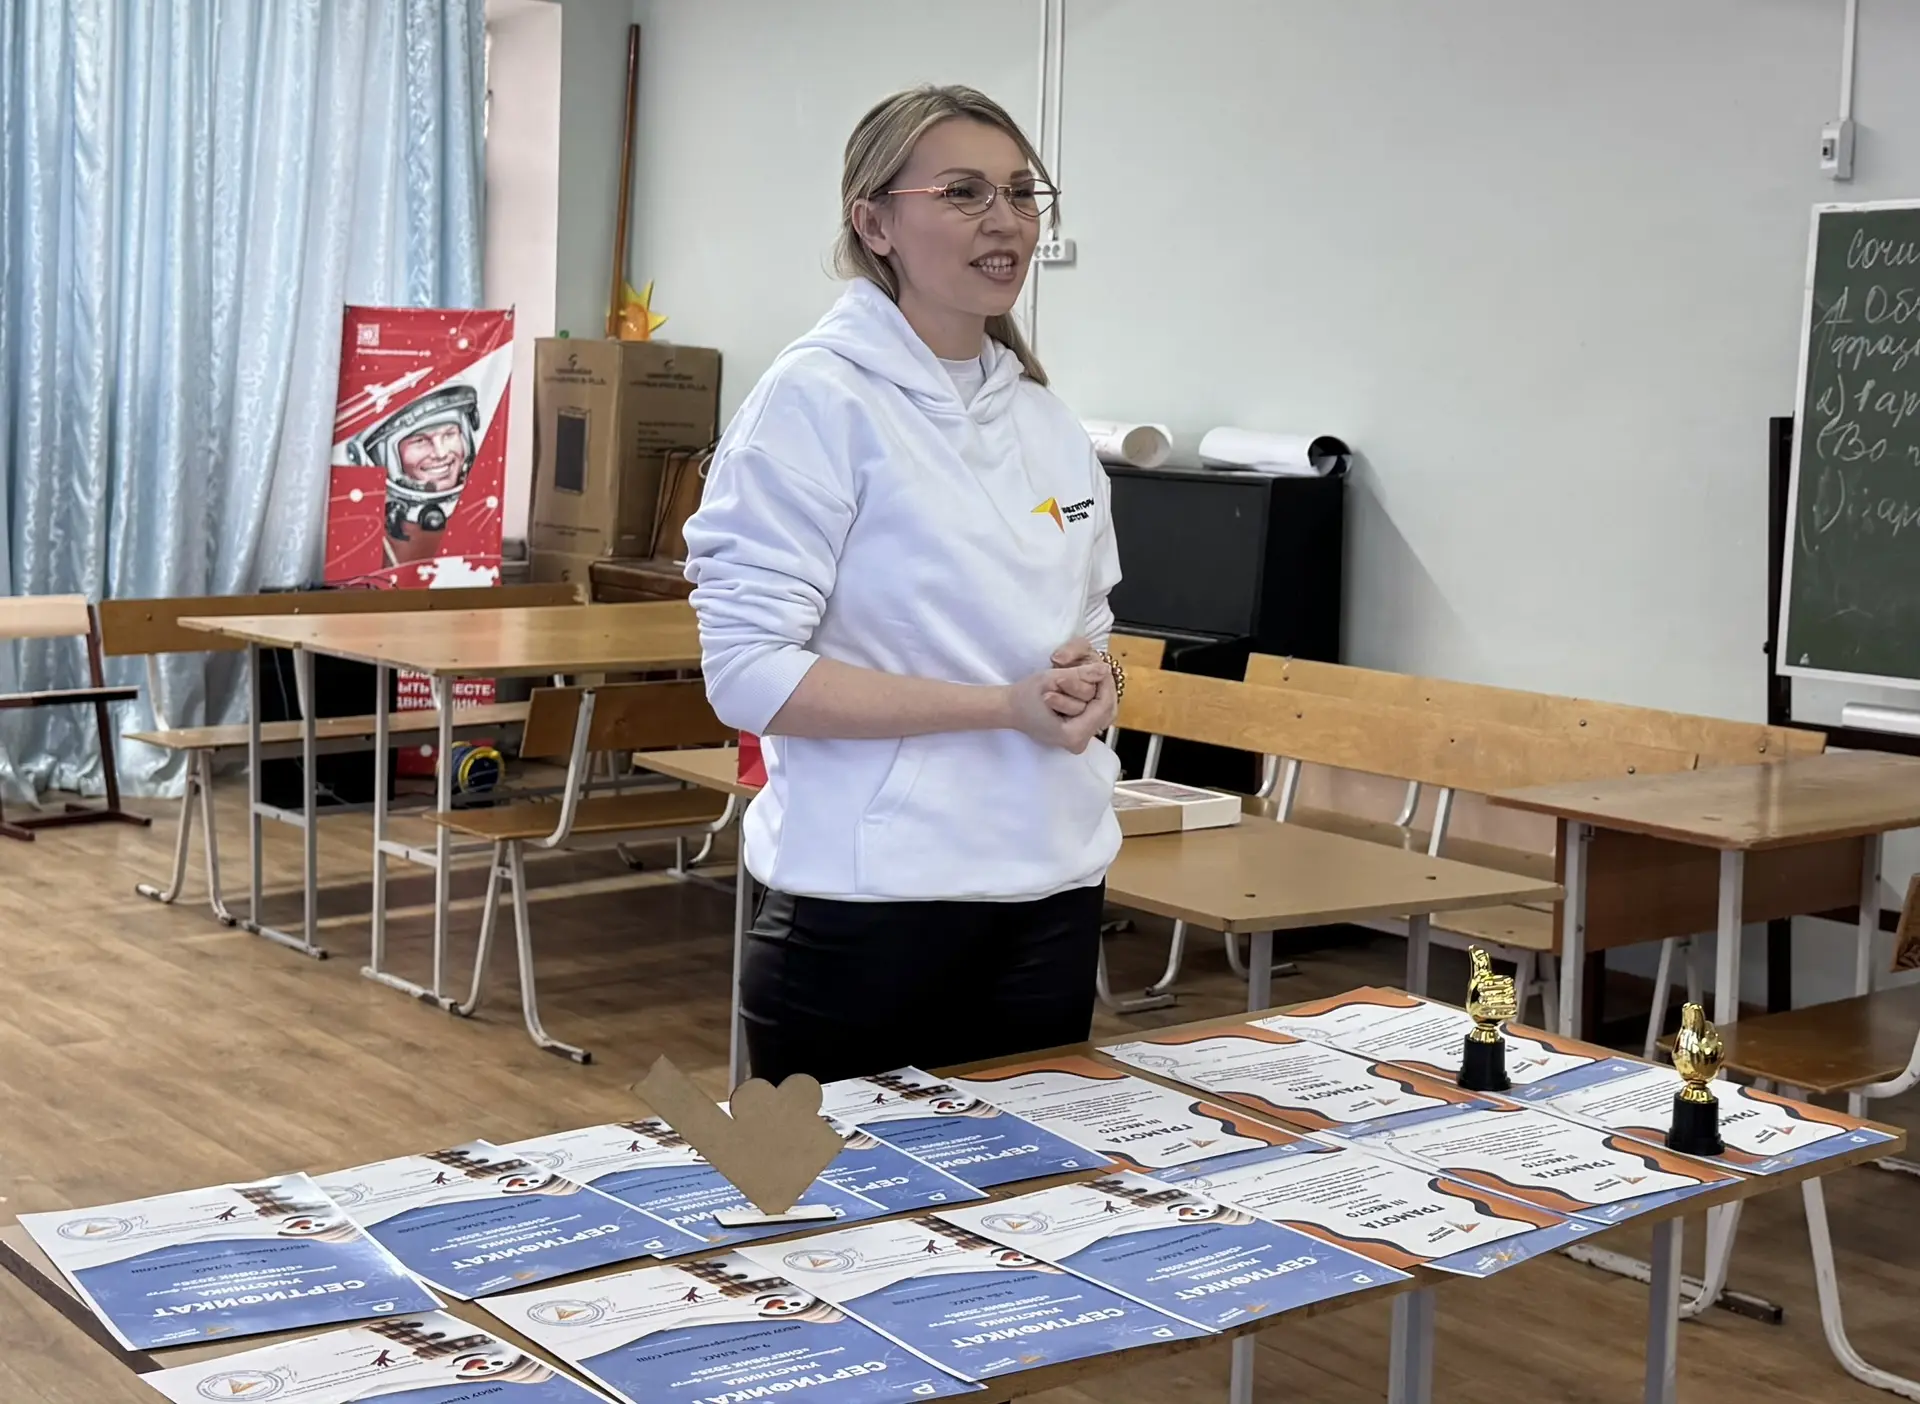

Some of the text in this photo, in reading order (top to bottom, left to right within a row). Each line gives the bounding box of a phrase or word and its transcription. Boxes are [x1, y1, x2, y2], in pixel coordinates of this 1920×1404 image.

[1295, 1084, 1374, 1101] ГРАМОТА
[1098, 1122, 1146, 1134] МЕСТО
[1106, 1124, 1193, 1143] ГРАМОТА
[932, 1145, 1039, 1168] СЕРТИФИ
[1531, 1160, 1615, 1178] ГРАМОТА
[1346, 1204, 1392, 1218] МЕСТО
[1360, 1204, 1444, 1229] ГРАМОТА
[453, 1224, 619, 1269] СЕРТИФИКАТ
[476, 1228, 561, 1249] УЧАСТНИКА
[1176, 1256, 1316, 1300] СЕРТИФИКАТ
[1188, 1258, 1260, 1280] УЧАСТНИКА
[198, 1278, 302, 1296] УЧАСТНИКА
[154, 1280, 364, 1317] СЕРТИФИКАТ
[953, 1308, 1124, 1348] СЕРТИФИКАТ
[975, 1308, 1062, 1327] УЧАСТНИКА
[722, 1362, 820, 1385] УЧАСТНИКА
